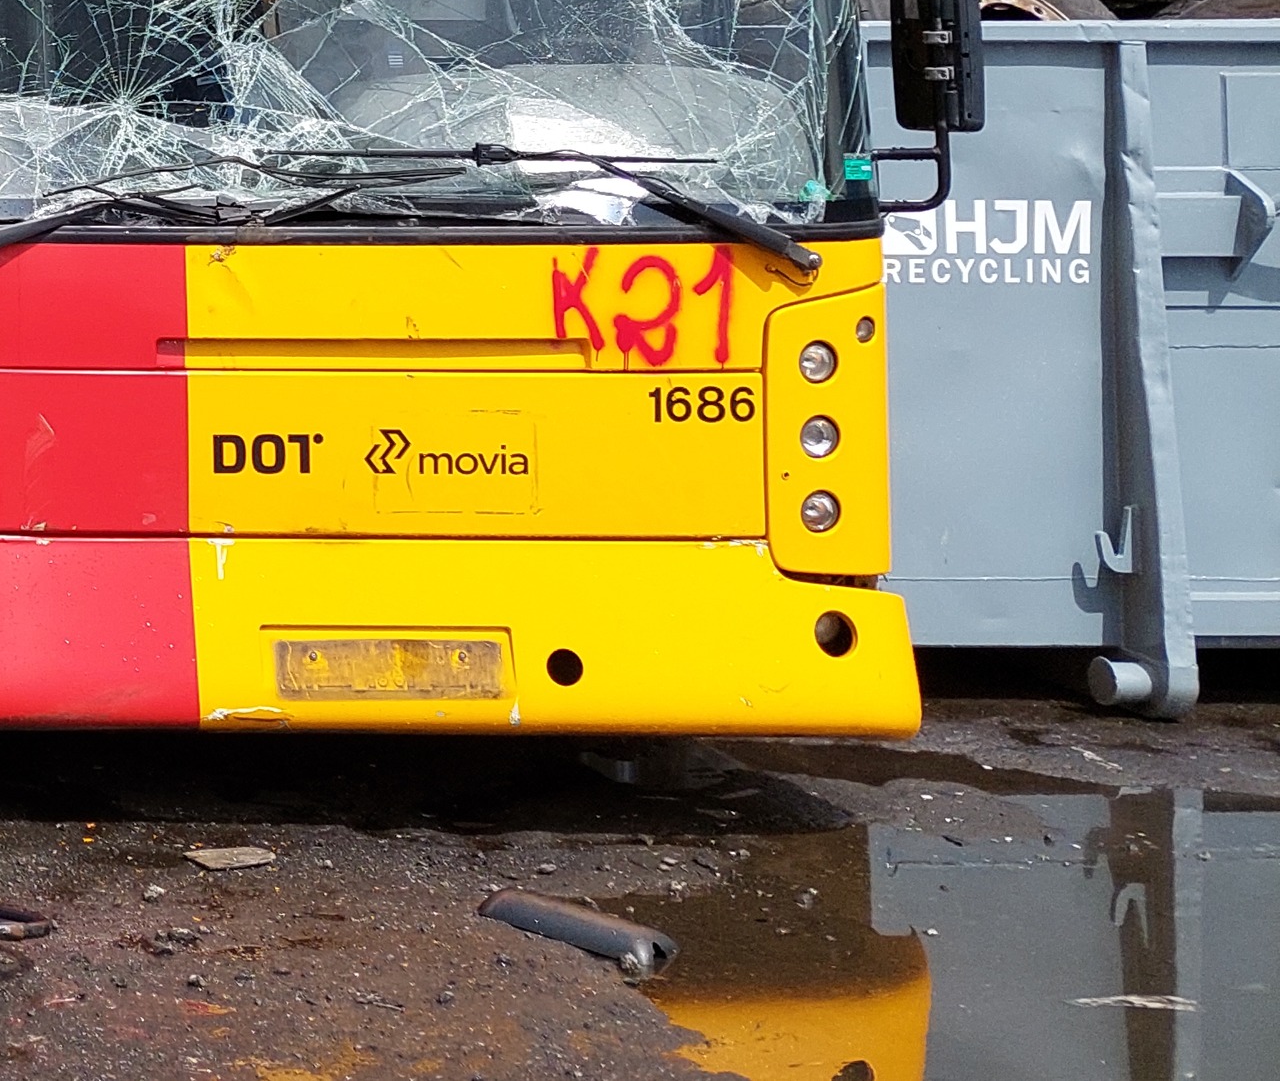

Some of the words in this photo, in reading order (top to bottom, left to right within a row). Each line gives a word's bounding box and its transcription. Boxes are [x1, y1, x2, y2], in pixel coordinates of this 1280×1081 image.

[944, 199, 1092, 255] HJM
[883, 258, 1090, 284] RECYCLING
[648, 385, 757, 423] 1686
[418, 444, 530, 476] movia
